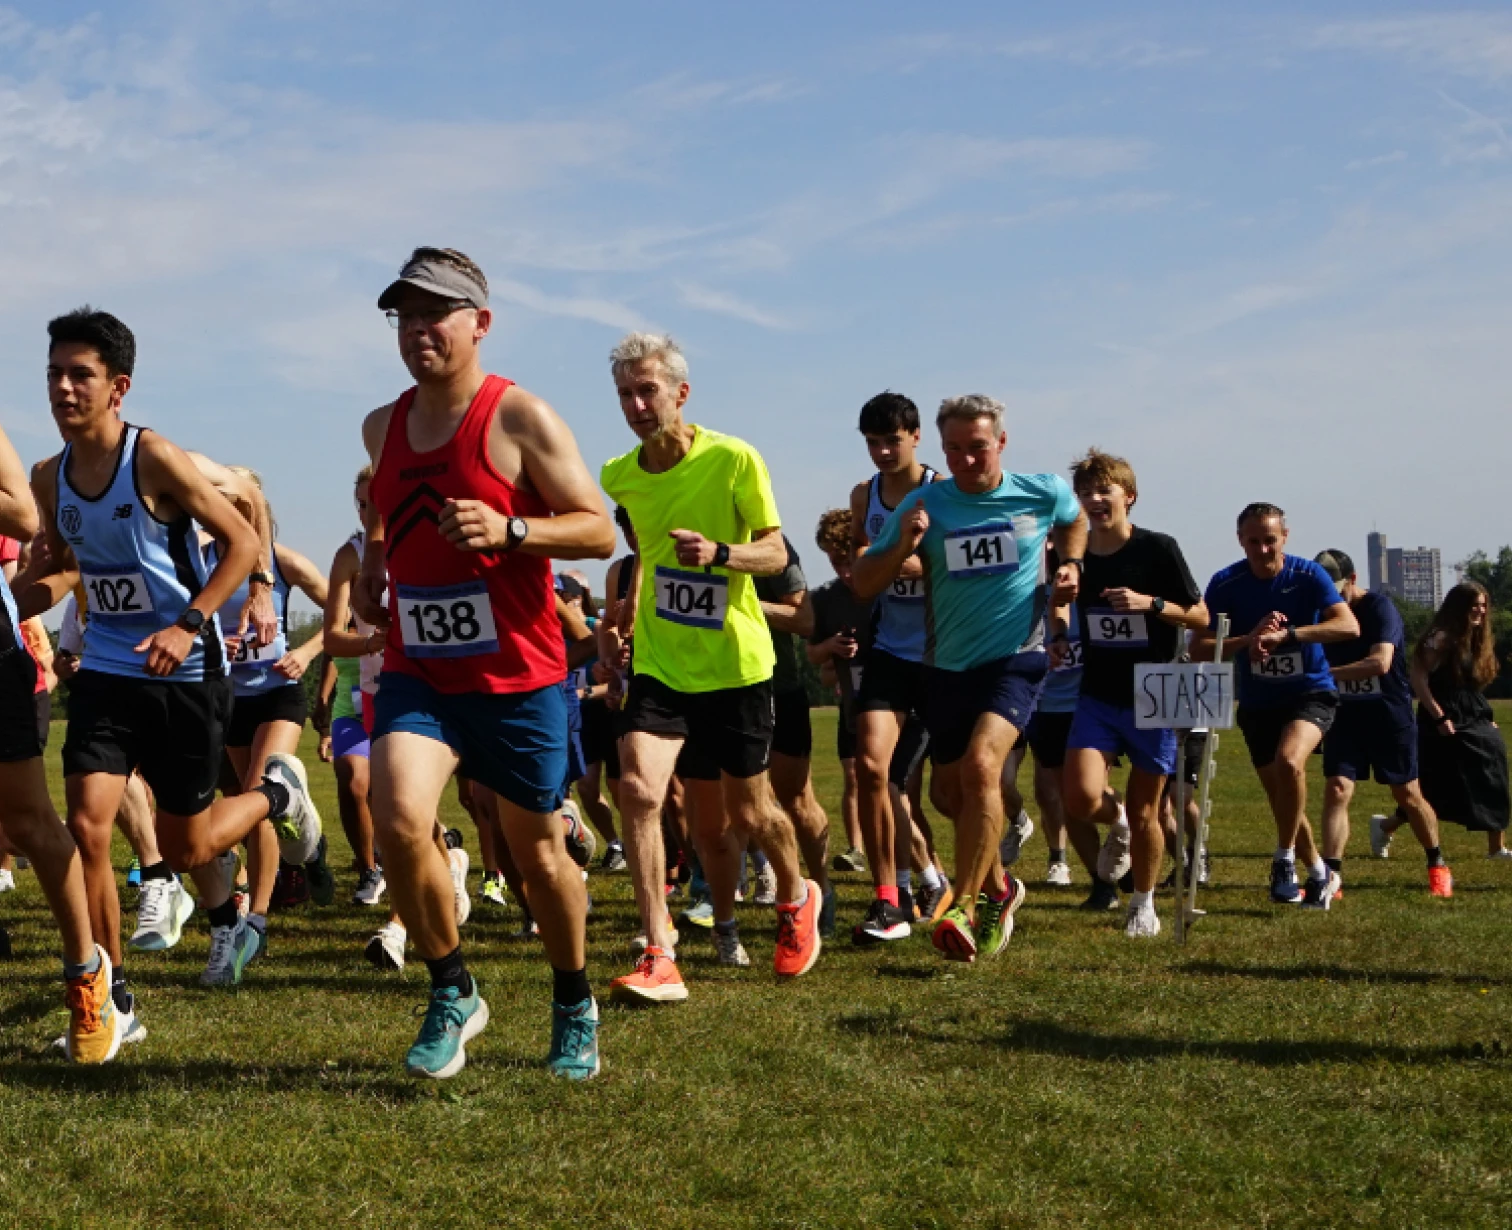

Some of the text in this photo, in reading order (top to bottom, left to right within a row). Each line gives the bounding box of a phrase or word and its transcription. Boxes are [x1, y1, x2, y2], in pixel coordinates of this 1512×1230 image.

[959, 535, 1004, 567] 141
[89, 578, 142, 611] 102
[664, 581, 717, 616] 104
[408, 600, 481, 644] 138
[1100, 616, 1134, 640] 94
[1259, 656, 1295, 677] 143
[1143, 672, 1229, 719] START
